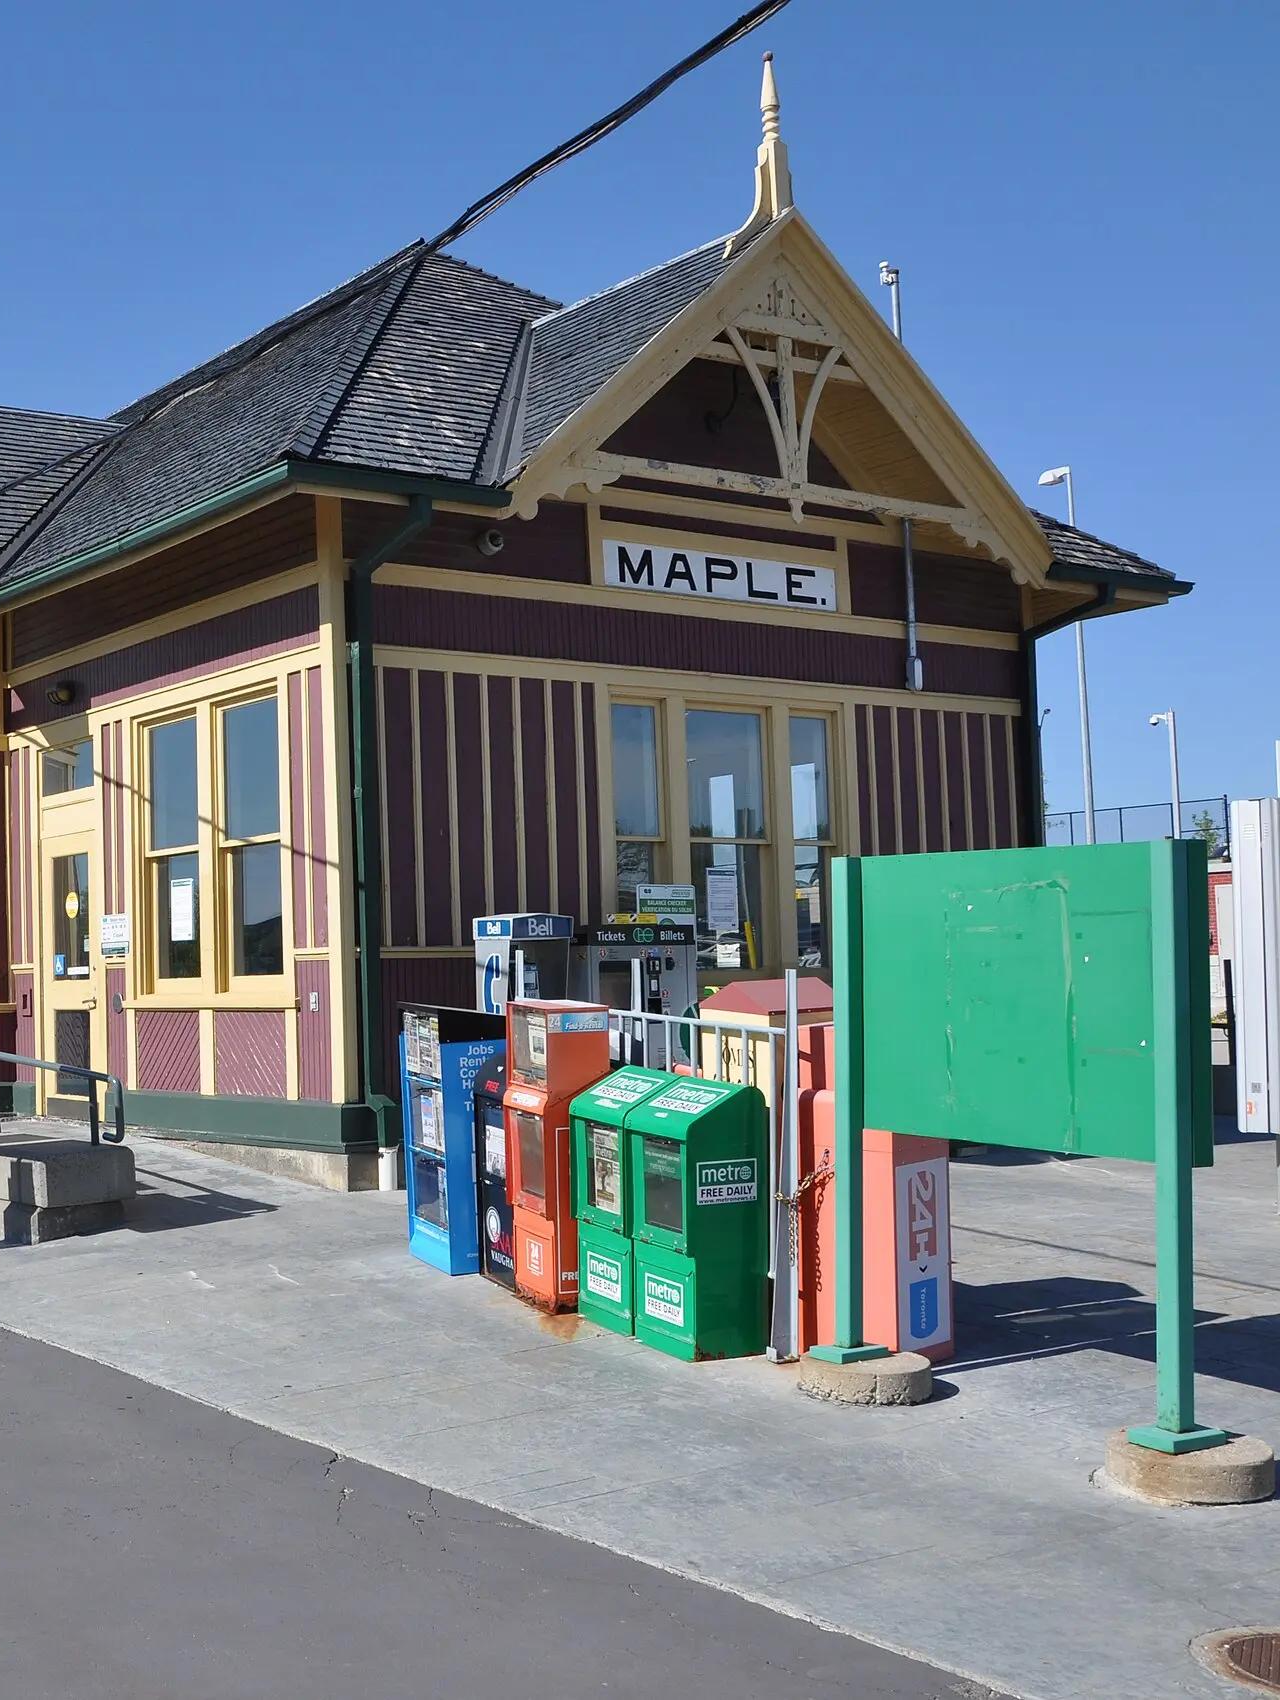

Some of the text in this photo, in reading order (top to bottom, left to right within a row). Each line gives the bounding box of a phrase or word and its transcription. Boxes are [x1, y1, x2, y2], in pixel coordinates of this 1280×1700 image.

[617, 545, 827, 606] MAPLE.
[486, 917, 554, 937] Bell Bell
[596, 931, 626, 942] Tickets
[660, 930, 685, 941] Billets
[467, 1044, 495, 1056] Jobs
[460, 1055, 486, 1067] Rent
[607, 1077, 653, 1093] metro
[666, 1087, 717, 1104] metro
[702, 1164, 752, 1184] metro
[700, 1185, 753, 1198] FREE DAILY
[490, 1249, 514, 1270] VAUGHA
[561, 1271, 579, 1282] FRE
[590, 1258, 618, 1281] metro
[589, 1275, 602, 1288] FREE
[603, 1280, 619, 1294] DAILY
[648, 1280, 680, 1304] metro
[647, 1298, 662, 1311] FREE
[663, 1303, 681, 1318] DAILY
